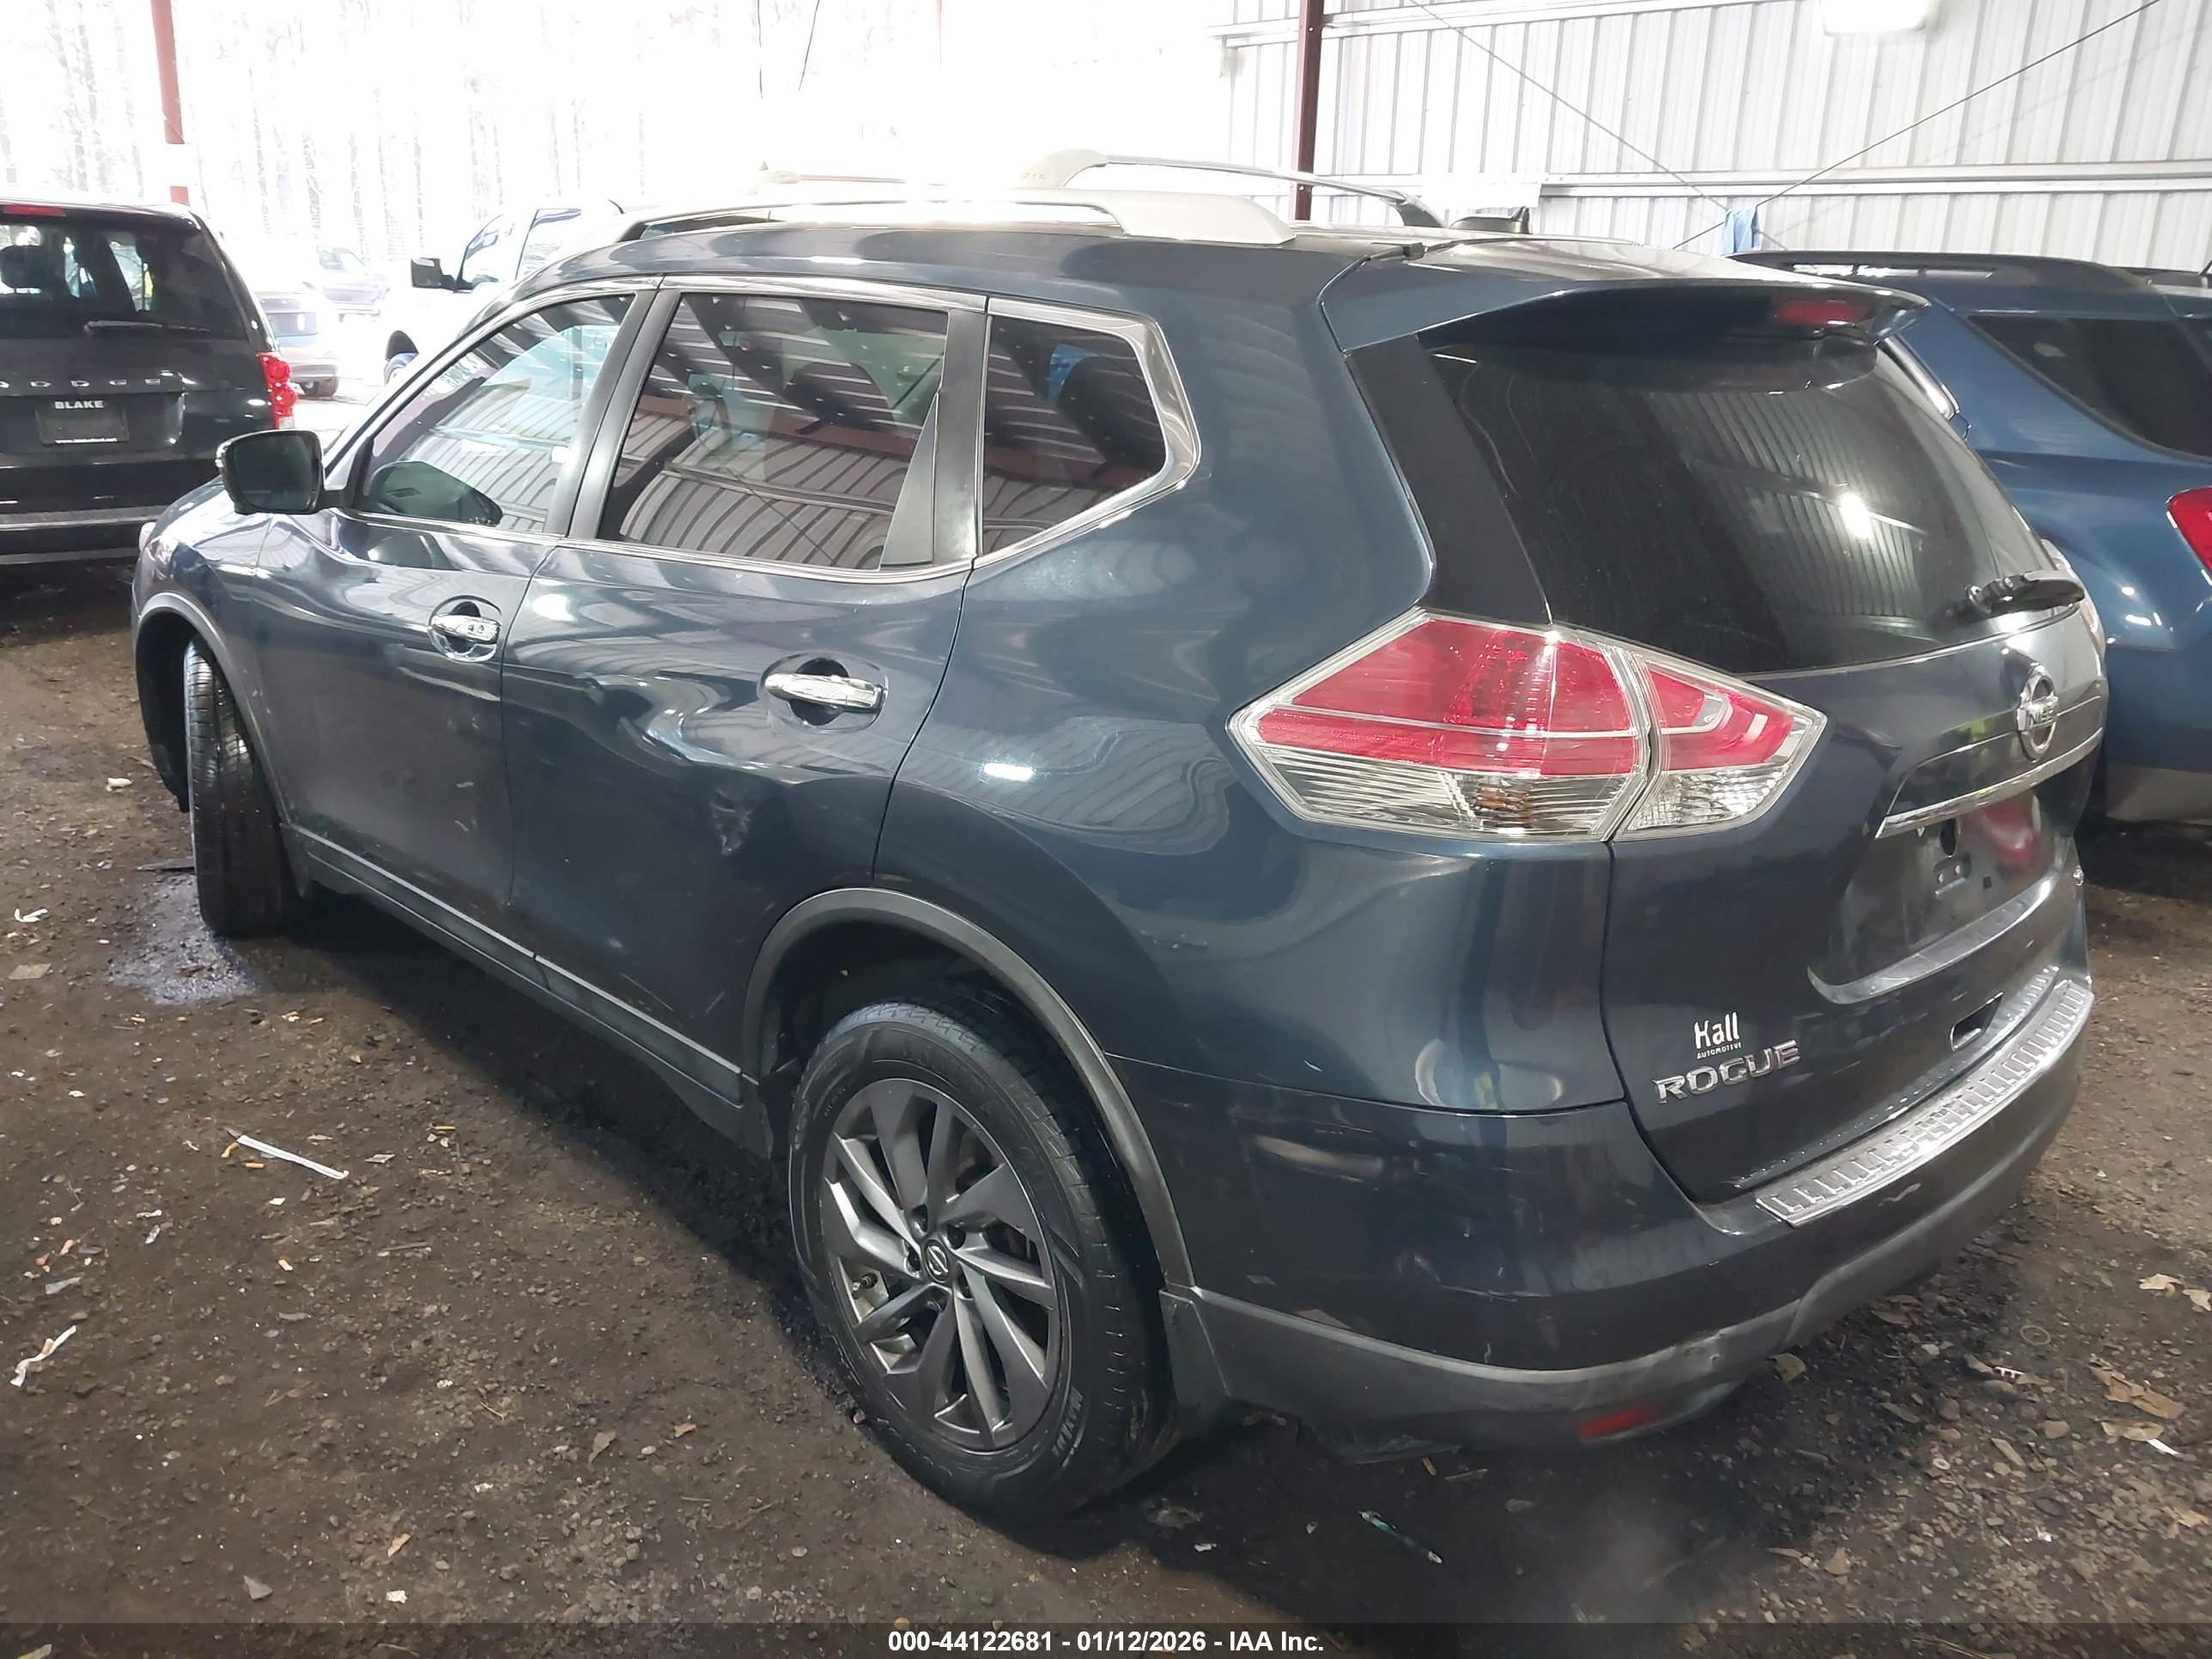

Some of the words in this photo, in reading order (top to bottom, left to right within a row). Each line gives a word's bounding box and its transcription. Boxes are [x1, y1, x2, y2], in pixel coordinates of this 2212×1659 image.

[54, 399, 104, 410] BLAKE
[1694, 1012, 1740, 1049] Hall
[1696, 1042, 1742, 1060] AUTOMOTIVE
[1652, 1039, 1802, 1104] ROGUE
